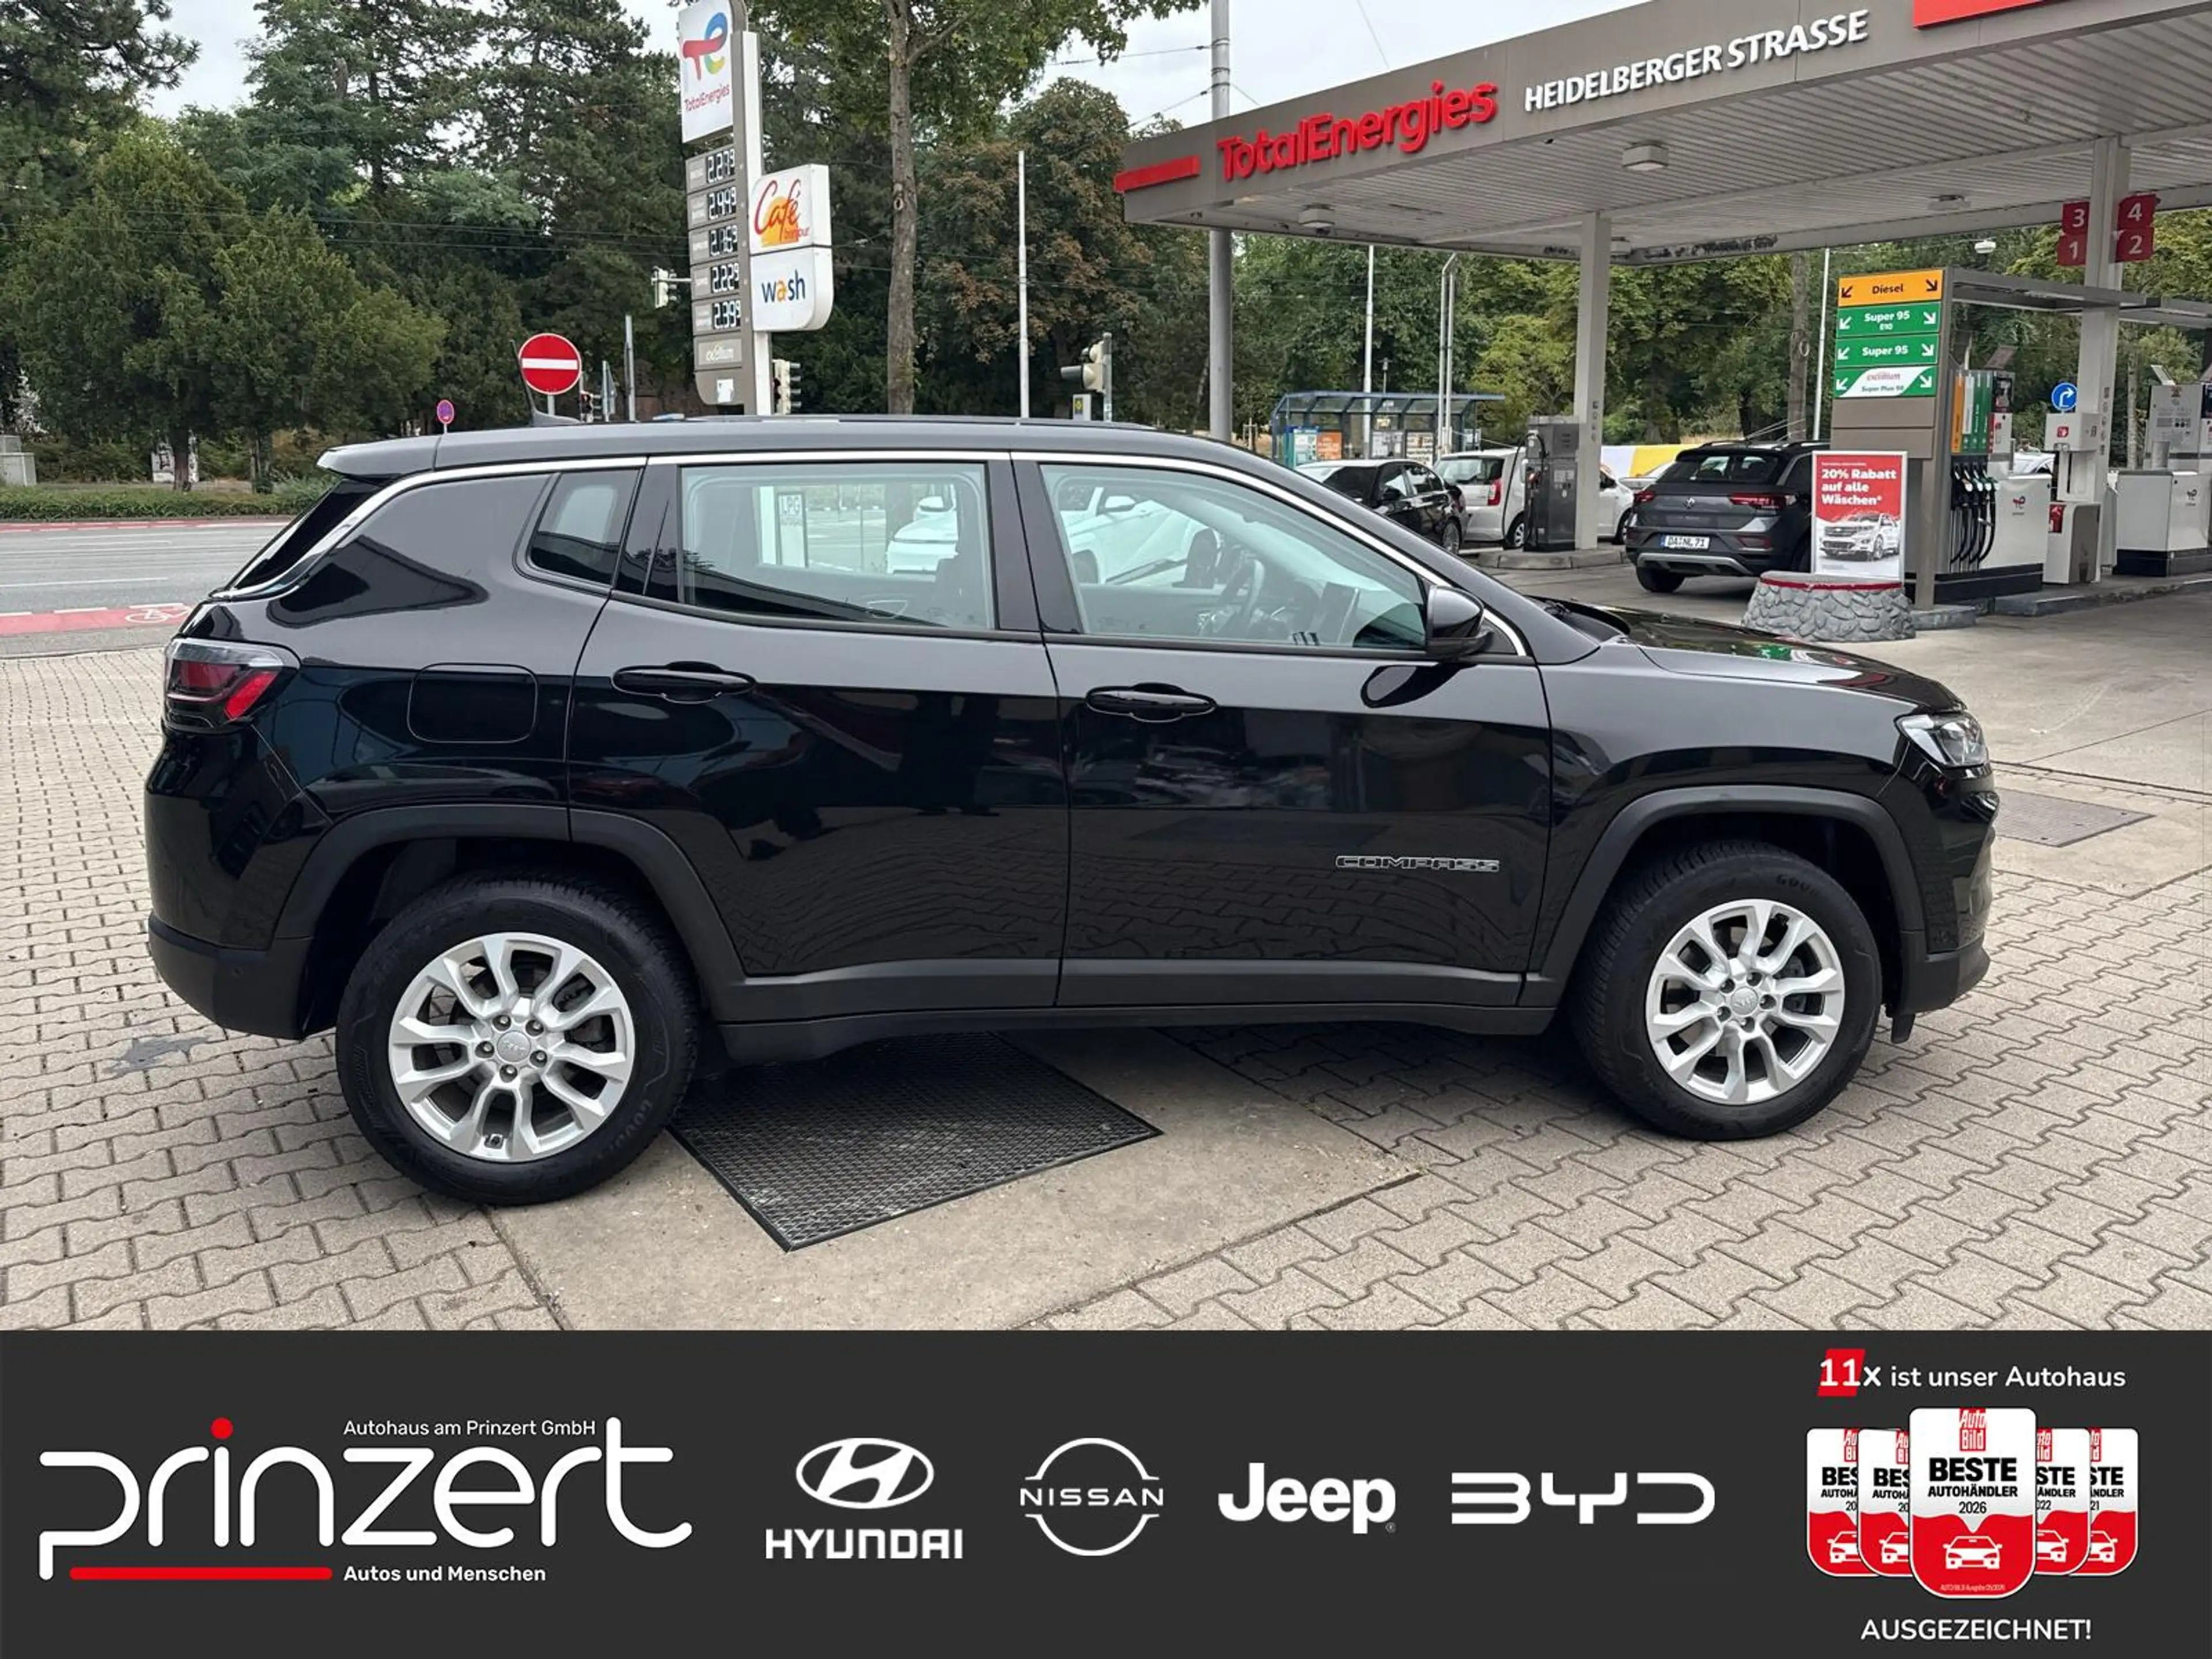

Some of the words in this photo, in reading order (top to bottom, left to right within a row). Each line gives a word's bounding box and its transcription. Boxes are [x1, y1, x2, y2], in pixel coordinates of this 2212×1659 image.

[1525, 44, 1723, 112] HEIDELBERGER
[1727, 9, 1869, 68] STRASSE
[684, 84, 730, 111] TotalEnergies
[1217, 80, 1497, 181] TotalEnergies
[753, 179, 801, 243] Café
[2073, 209, 2085, 228] 3
[2128, 202, 2142, 222] 4
[2069, 241, 2078, 260] 1
[2129, 235, 2143, 254] 2
[761, 269, 806, 304] wash
[1872, 283, 1904, 294] Diesel
[1864, 313, 1895, 323] Super
[1896, 310, 1910, 320] 95
[1862, 347, 1893, 357] Super
[1895, 345, 1908, 355] 95
[1821, 468, 1849, 479] 20%
[1851, 468, 1896, 479] Rabatt
[1821, 481, 1842, 491] auf
[1844, 481, 1869, 492] alle
[1336, 855, 1499, 872] COMPASS
